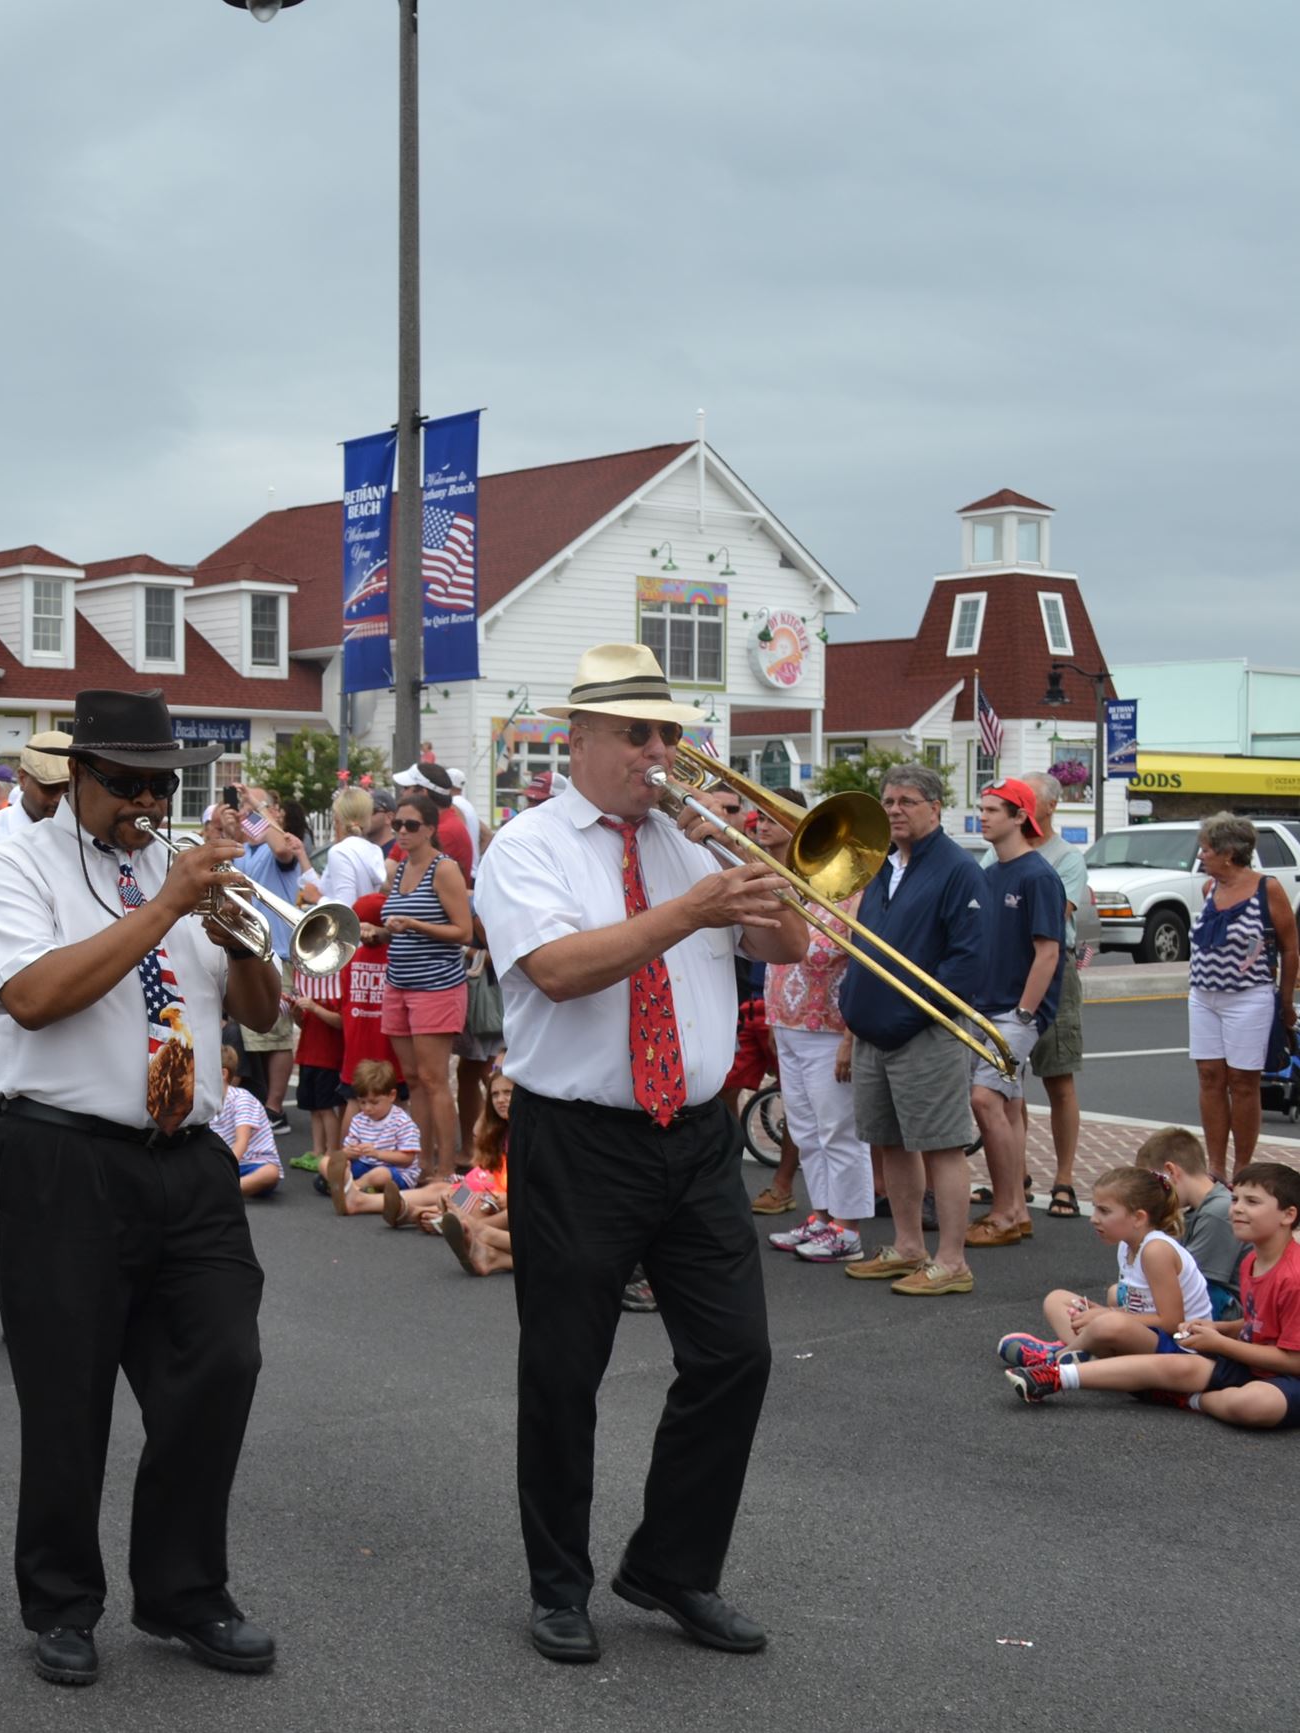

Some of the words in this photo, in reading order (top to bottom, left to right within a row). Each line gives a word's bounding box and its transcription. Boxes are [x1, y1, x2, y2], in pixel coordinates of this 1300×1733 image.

[425, 471, 458, 487] Welcome
[344, 484, 387, 506] BETHANY
[448, 481, 475, 497] Beach
[348, 500, 381, 519] BEACH
[351, 543, 371, 566] You
[433, 615, 450, 628] Quiet
[450, 613, 475, 624] Resort
[1108, 706, 1135, 714] BETHANY
[220, 725, 228, 738] &
[351, 971, 387, 990] ROCK
[350, 990, 369, 1003] THE
[369, 991, 384, 1004] RE
